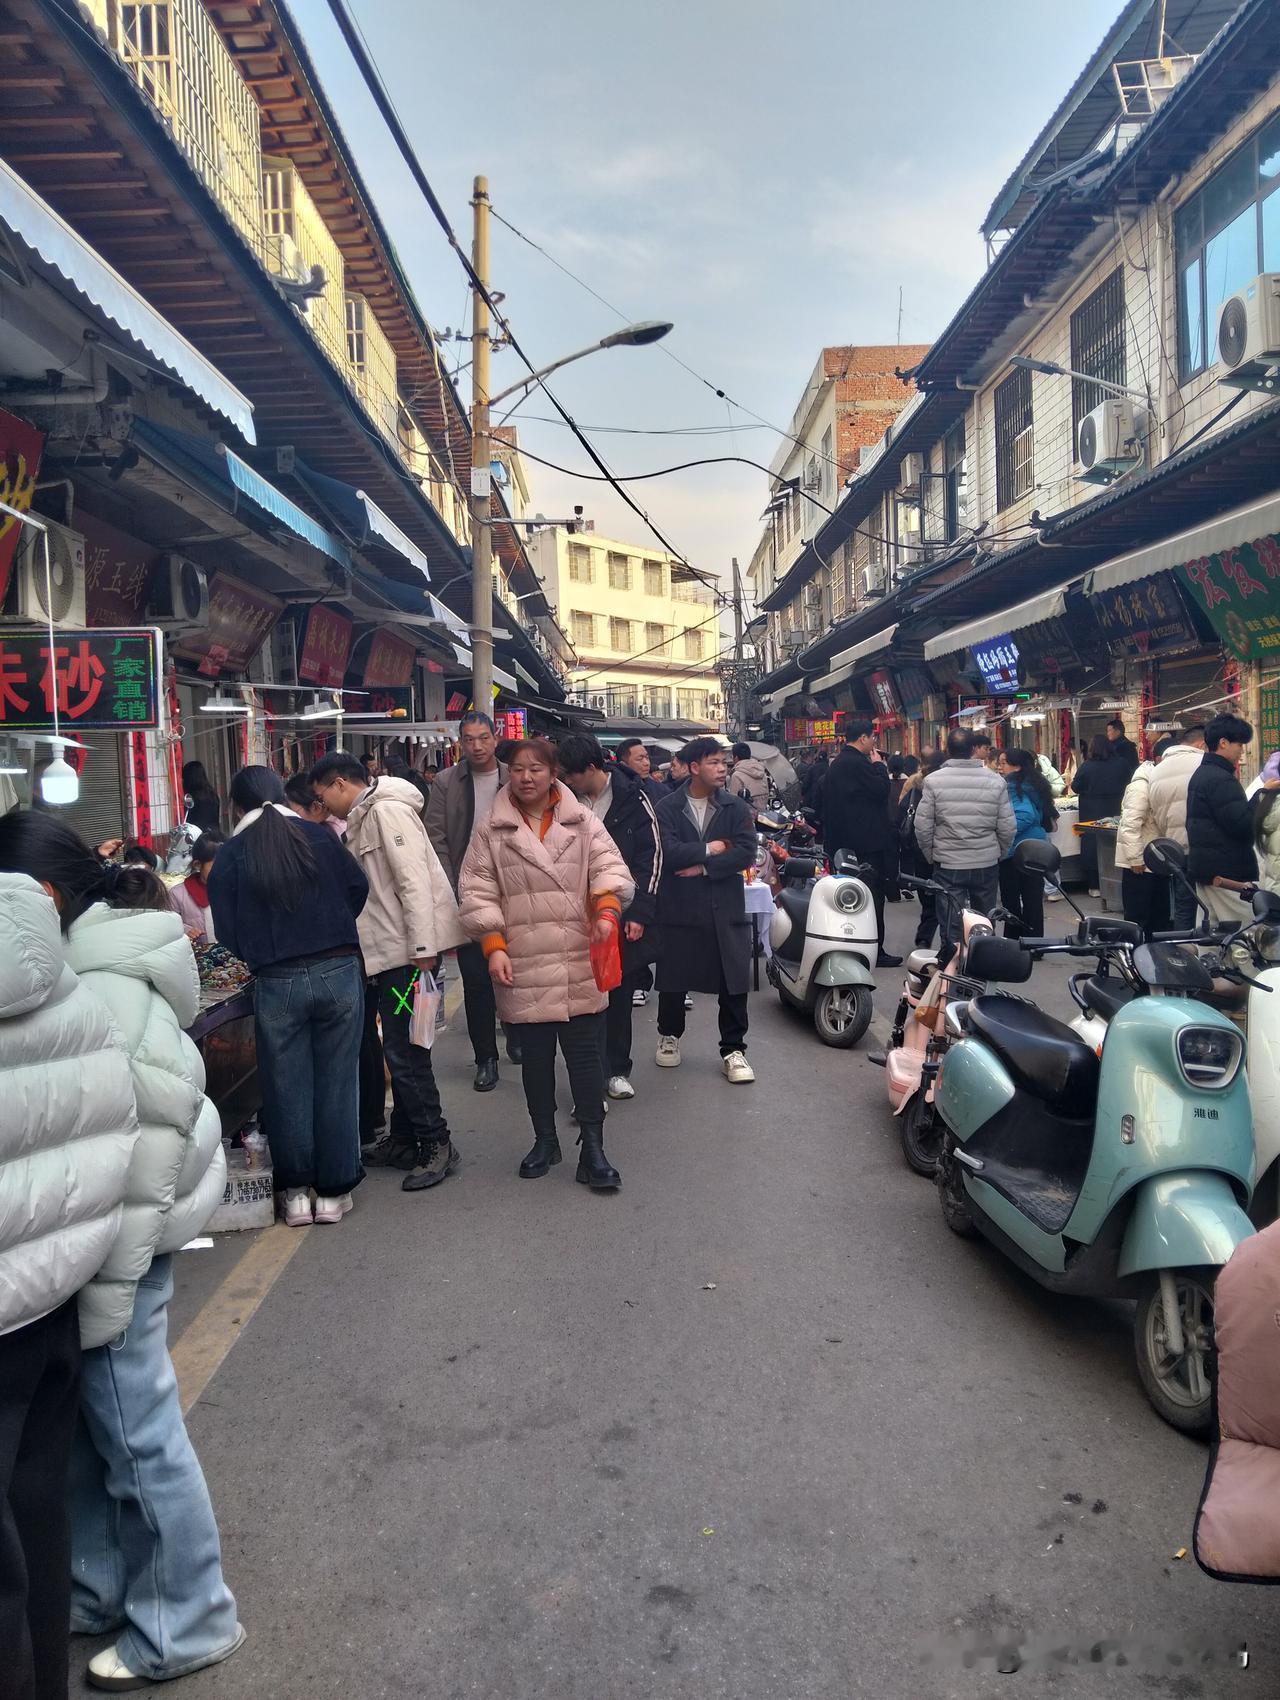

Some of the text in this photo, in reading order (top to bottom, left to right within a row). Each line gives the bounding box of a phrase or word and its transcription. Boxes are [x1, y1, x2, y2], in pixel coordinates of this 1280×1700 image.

[111, 637, 147, 719] 厂家直销
[1194, 1107, 1220, 1120] 雅迪
